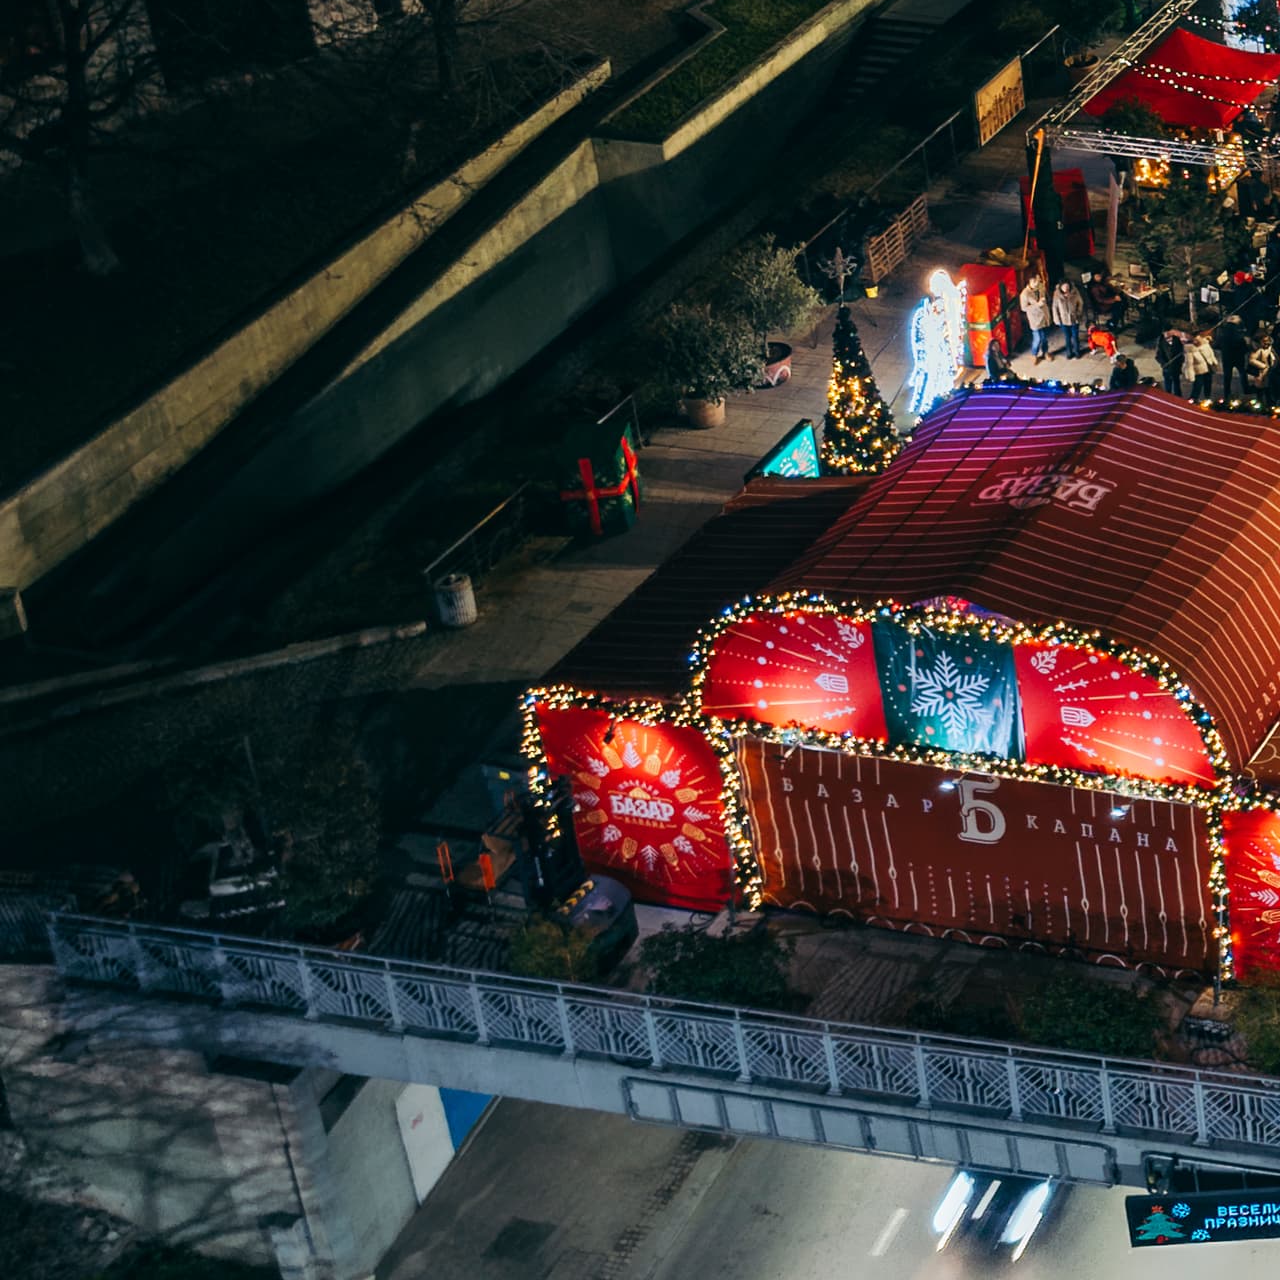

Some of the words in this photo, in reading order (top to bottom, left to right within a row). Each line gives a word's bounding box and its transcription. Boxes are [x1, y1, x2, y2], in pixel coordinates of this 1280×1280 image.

[978, 474, 1112, 511] БАЗАР
[609, 794, 674, 822] БАЗАР
[783, 778, 934, 813] БАЗАР
[1026, 814, 1179, 853] КАПАНА
